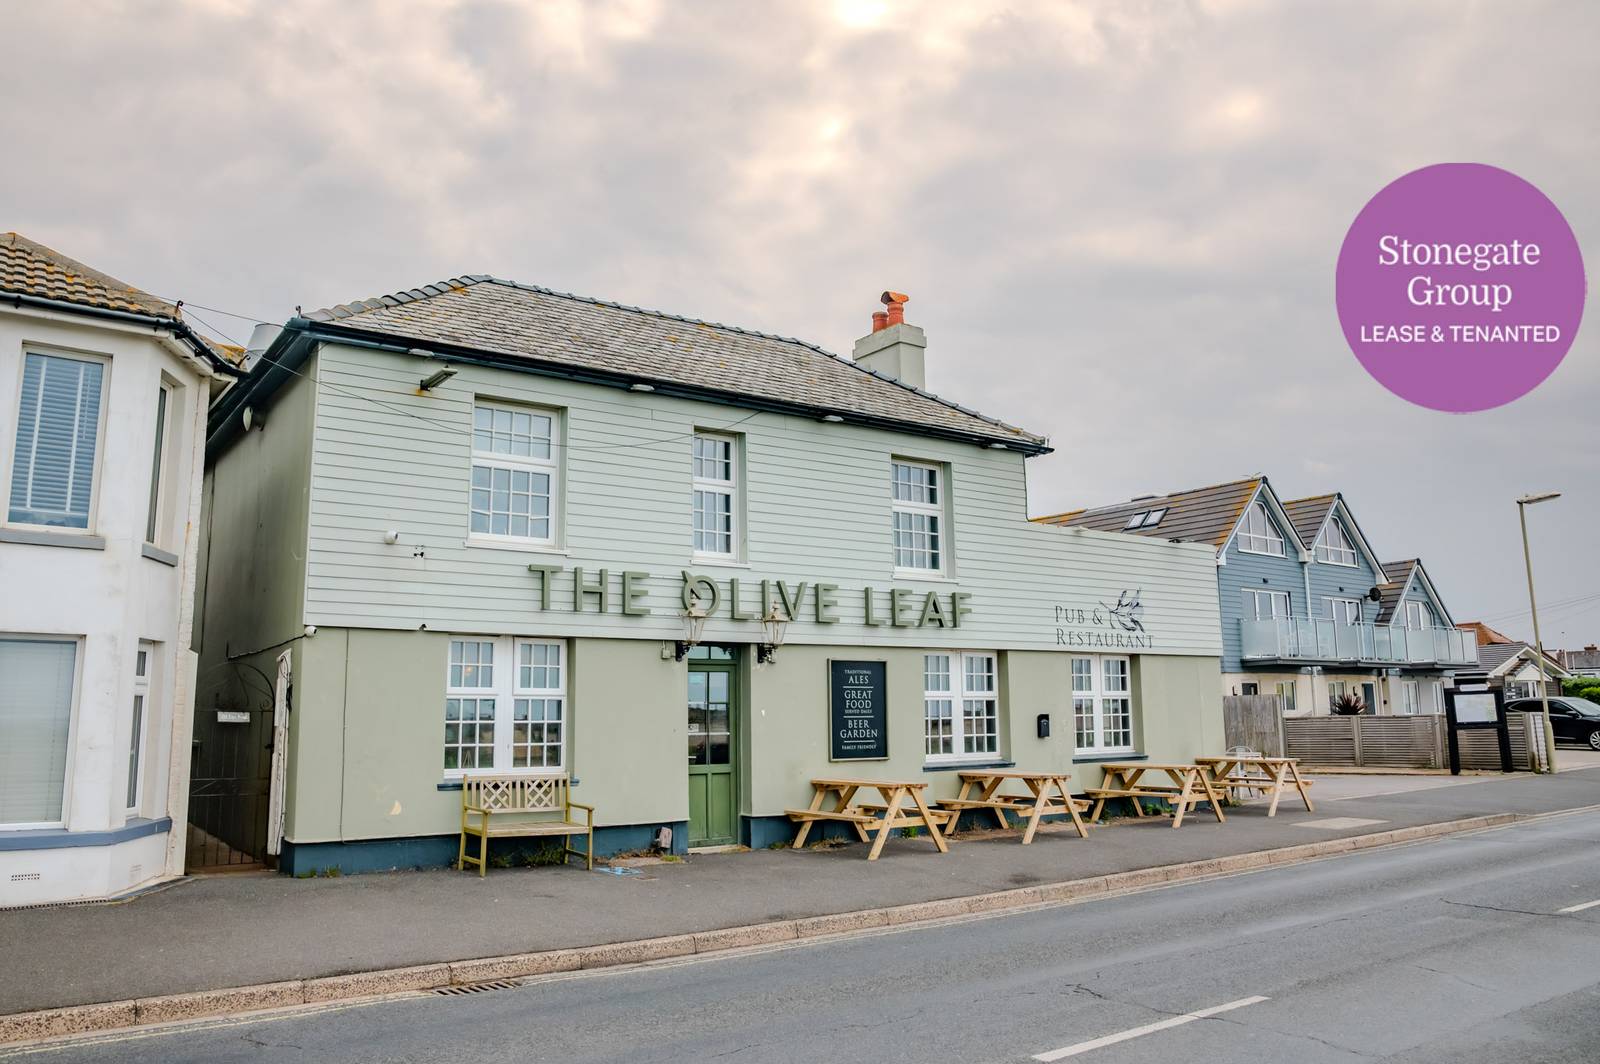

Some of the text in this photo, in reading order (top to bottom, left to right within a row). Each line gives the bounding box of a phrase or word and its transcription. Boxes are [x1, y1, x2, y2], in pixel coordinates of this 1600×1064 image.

[529, 564, 973, 628] THE OLIVE LEAF
[1092, 608, 1103, 625] &
[1056, 628, 1154, 649] RESTAURANT
[848, 675, 869, 684] ALES
[844, 690, 873, 699] GREAT
[845, 699, 872, 709] FOOD
[848, 719, 870, 729] BEER
[840, 729, 878, 738] GARDEN
